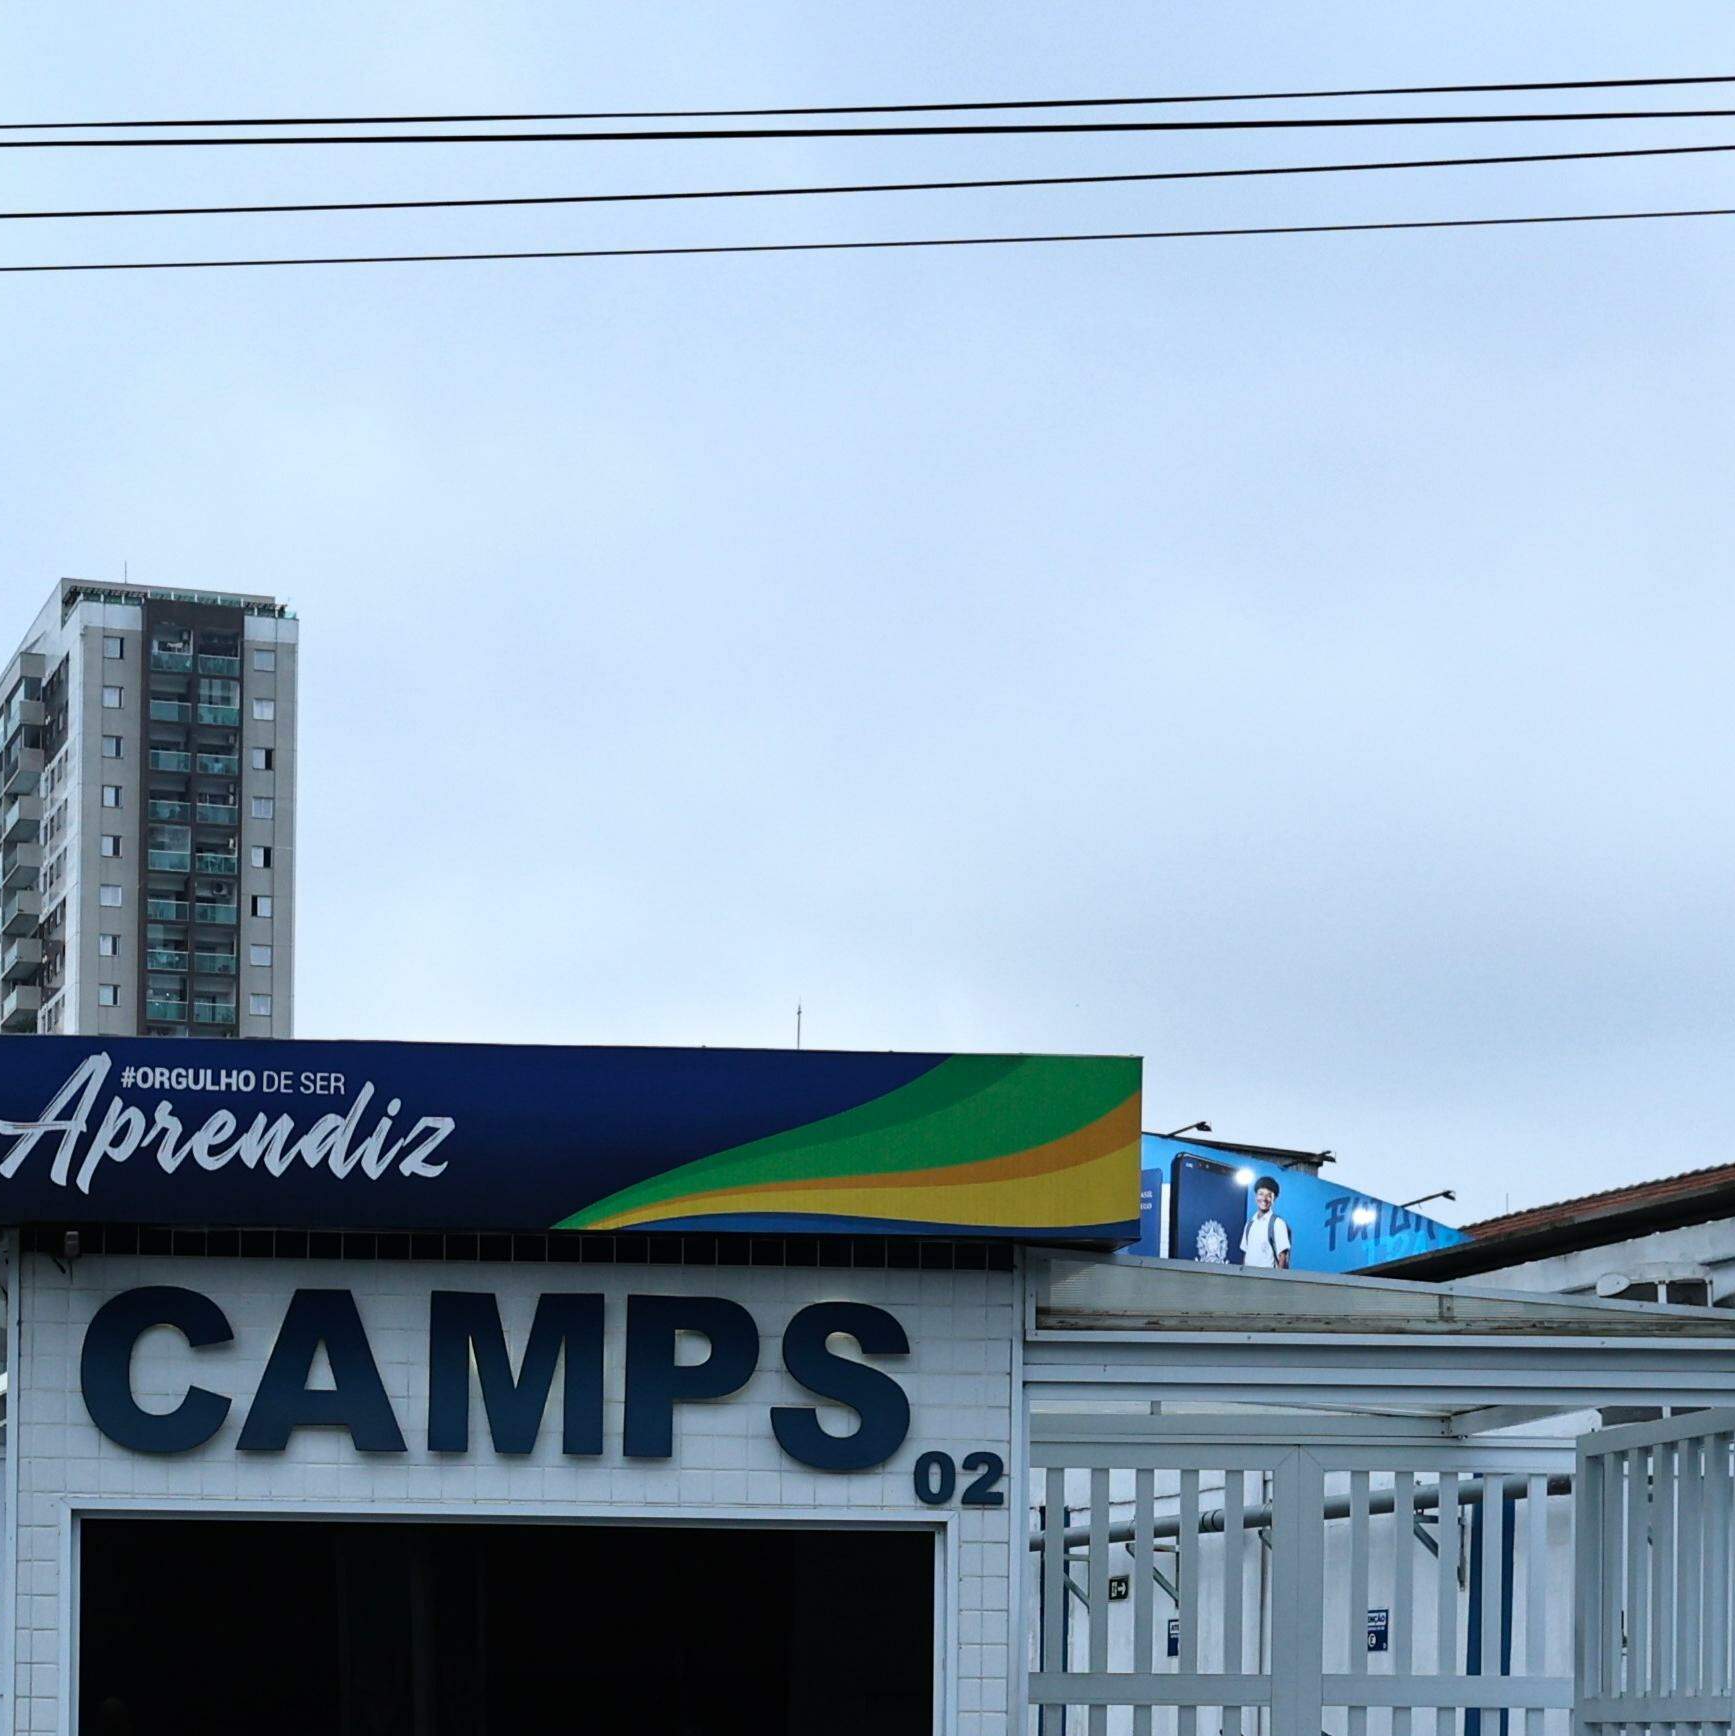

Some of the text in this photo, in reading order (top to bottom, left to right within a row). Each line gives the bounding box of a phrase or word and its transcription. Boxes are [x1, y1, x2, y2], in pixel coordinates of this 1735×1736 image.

[120, 1066, 346, 1095] #ORGULHO DE SER
[81, 1285, 1004, 1505] CAMPS 02
